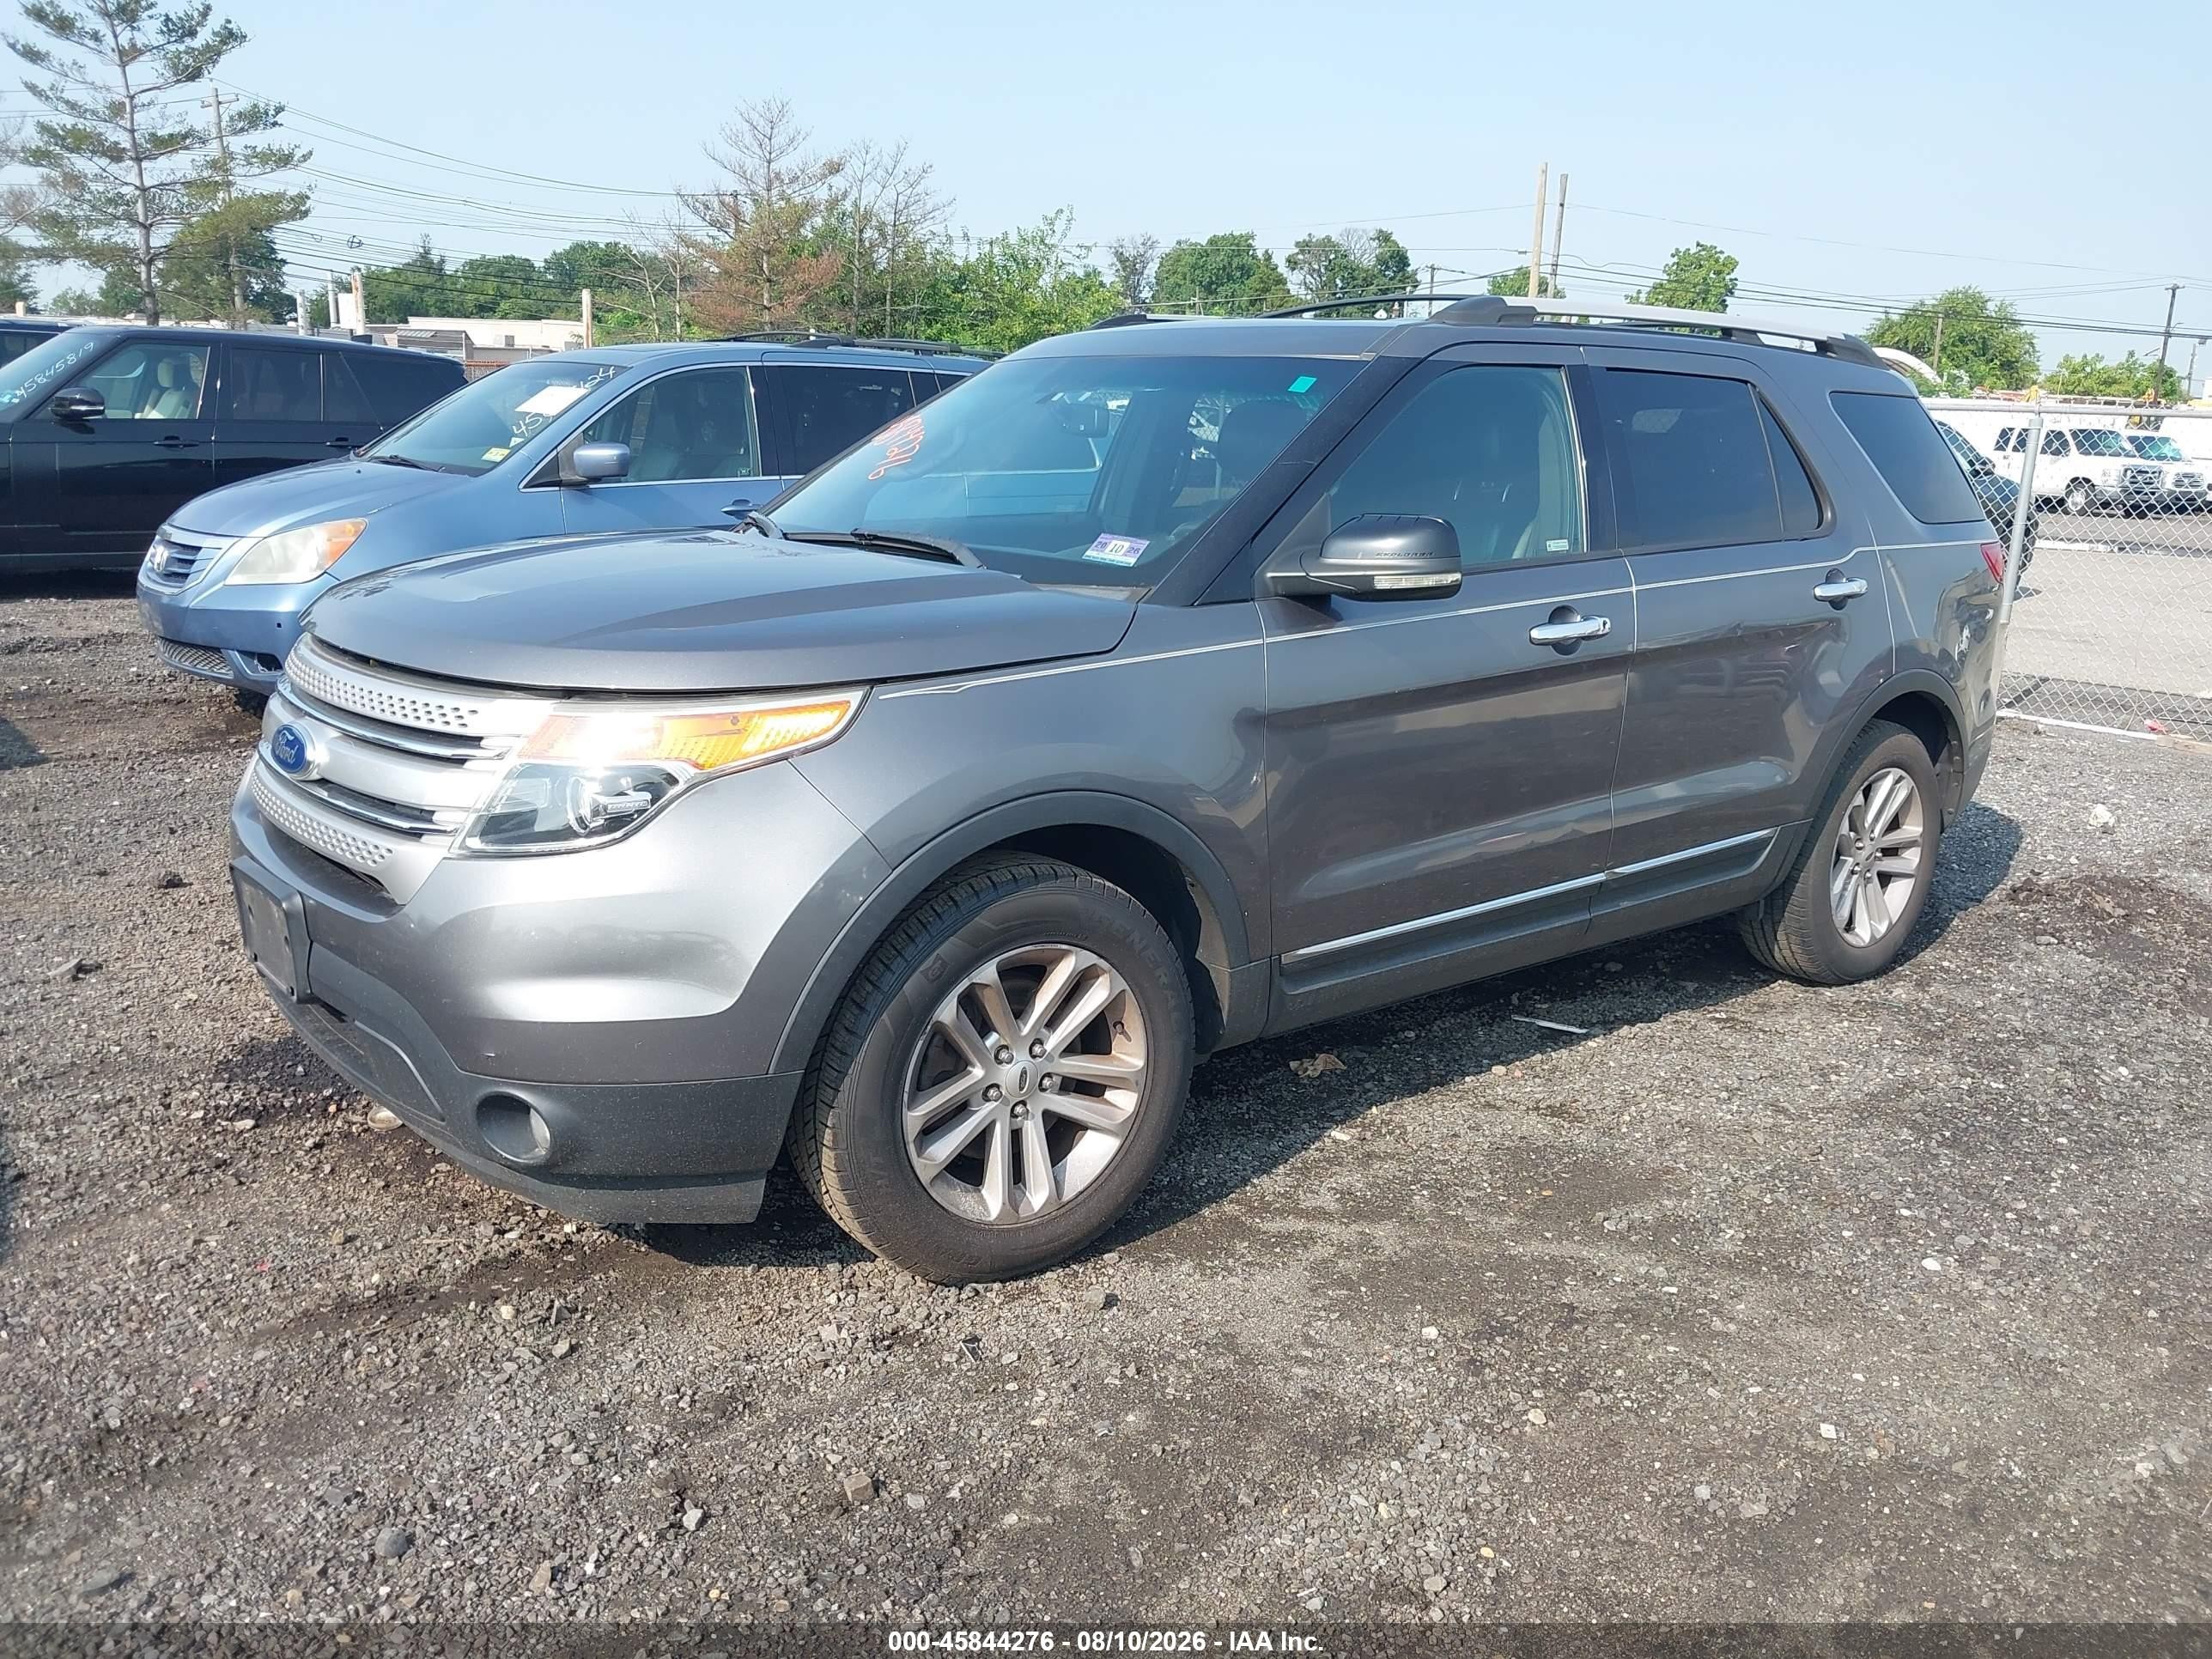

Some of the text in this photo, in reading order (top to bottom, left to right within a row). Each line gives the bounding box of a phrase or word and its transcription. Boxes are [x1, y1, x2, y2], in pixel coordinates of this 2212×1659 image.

[15, 342, 94, 398] 45845819
[1109, 543, 1124, 554] 10
[276, 730, 299, 763] Ford
